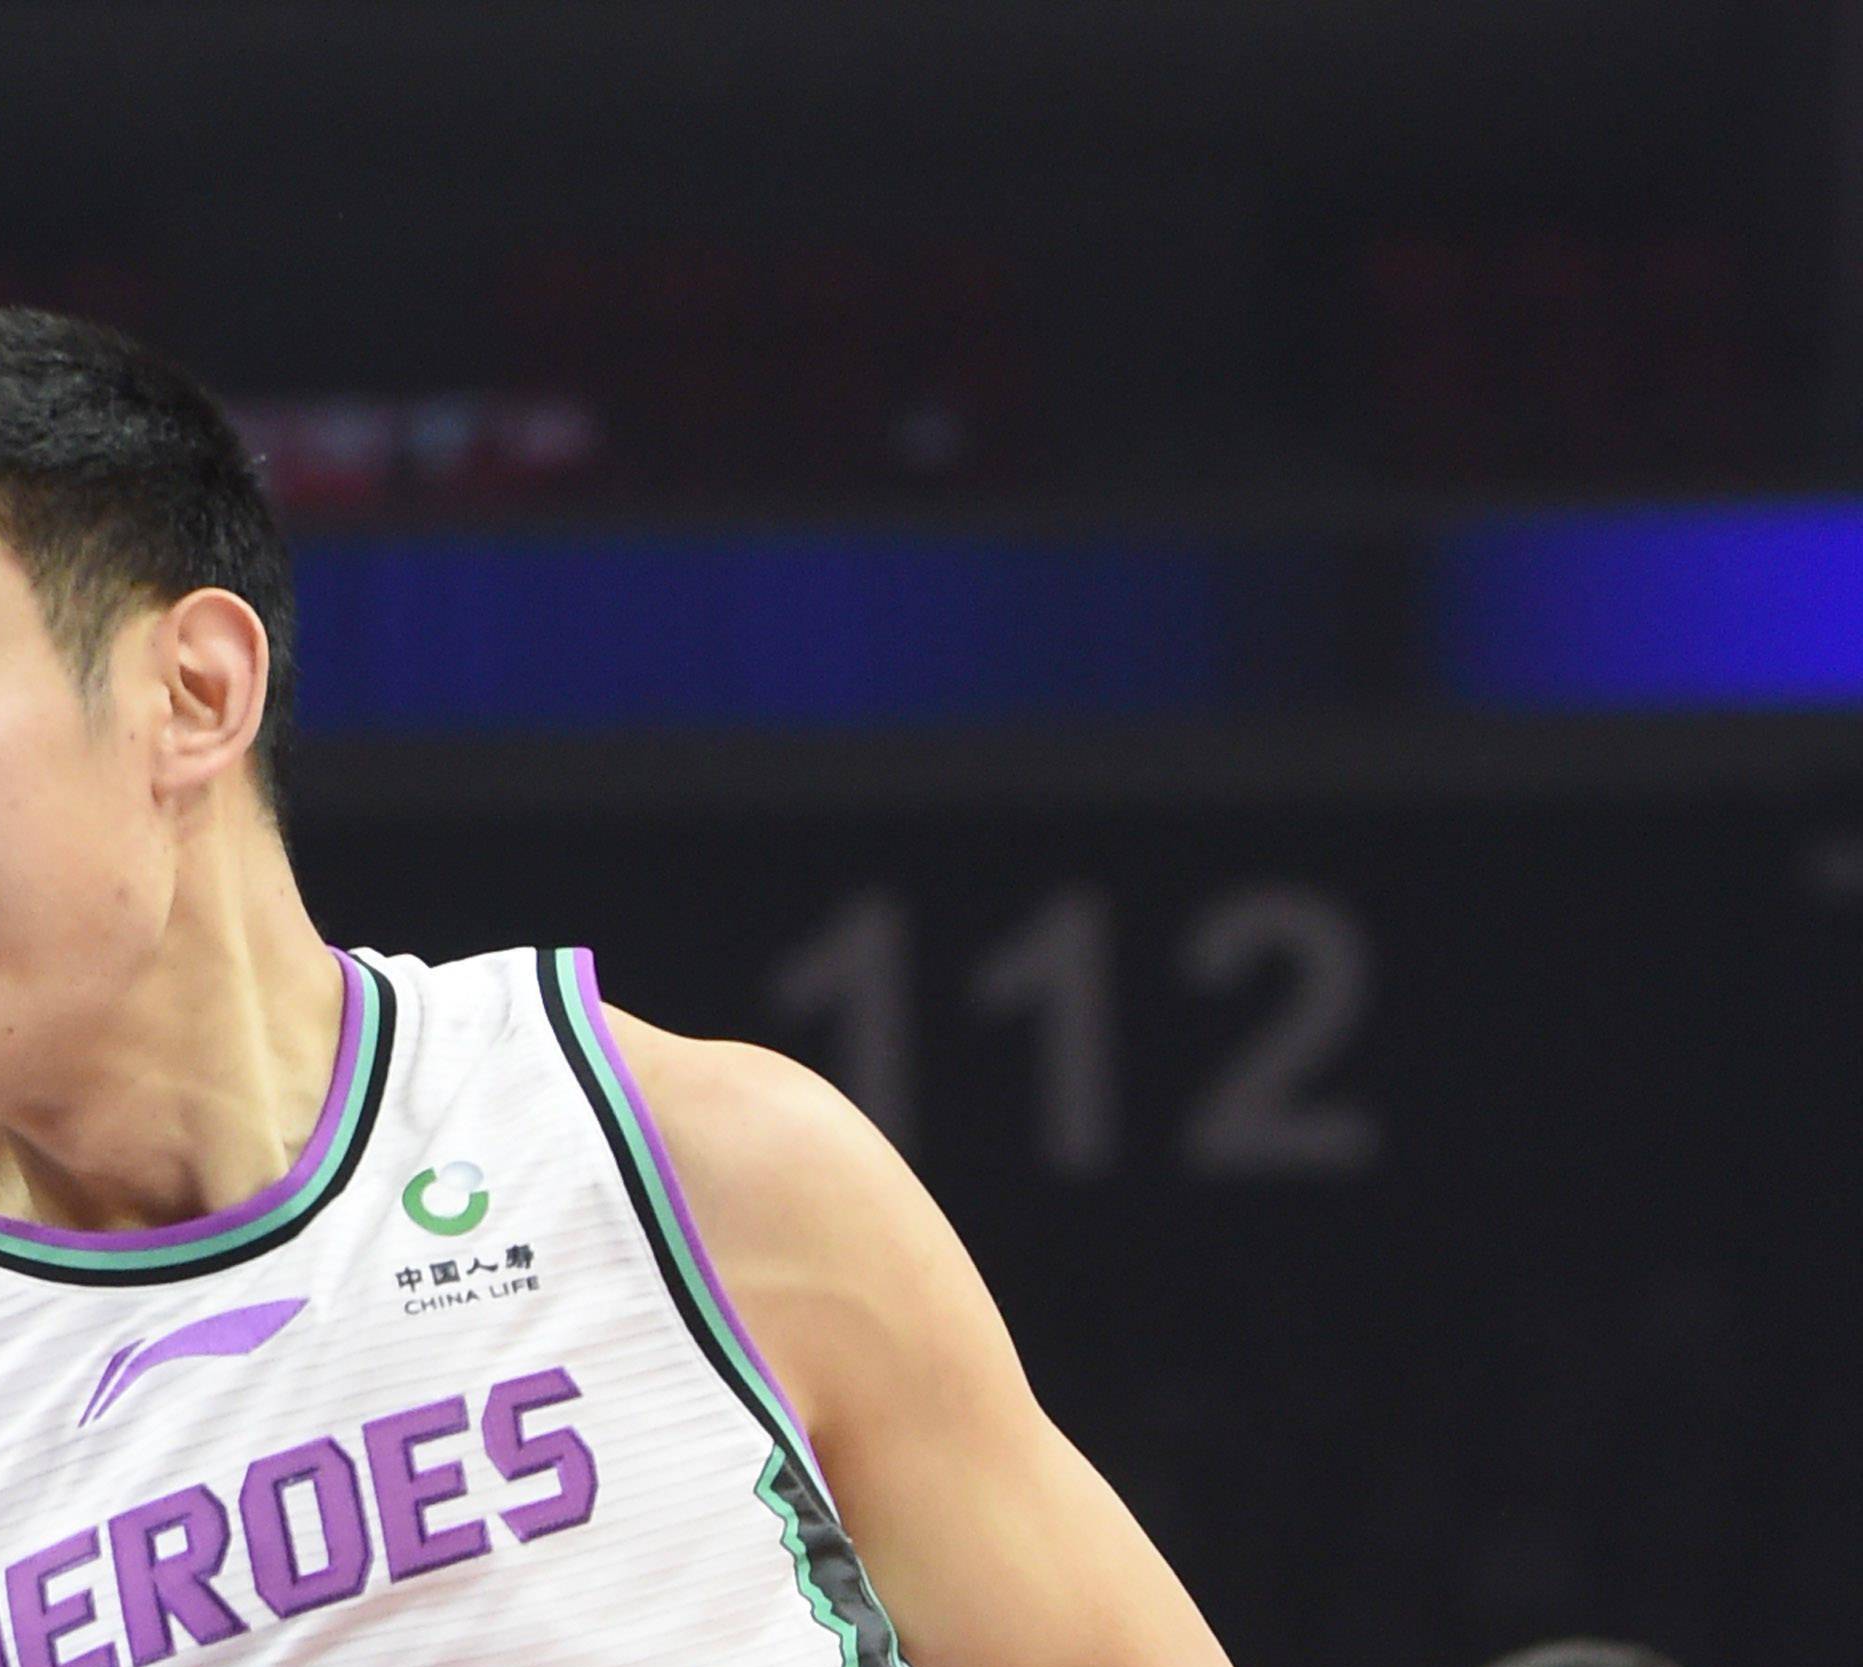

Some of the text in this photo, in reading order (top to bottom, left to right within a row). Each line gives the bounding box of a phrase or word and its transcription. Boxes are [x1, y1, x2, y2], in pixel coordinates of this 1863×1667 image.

[771, 882, 1378, 1172] 112
[395, 1243, 534, 1292] 中国人寿
[404, 1275, 540, 1315] CHINA LIFE
